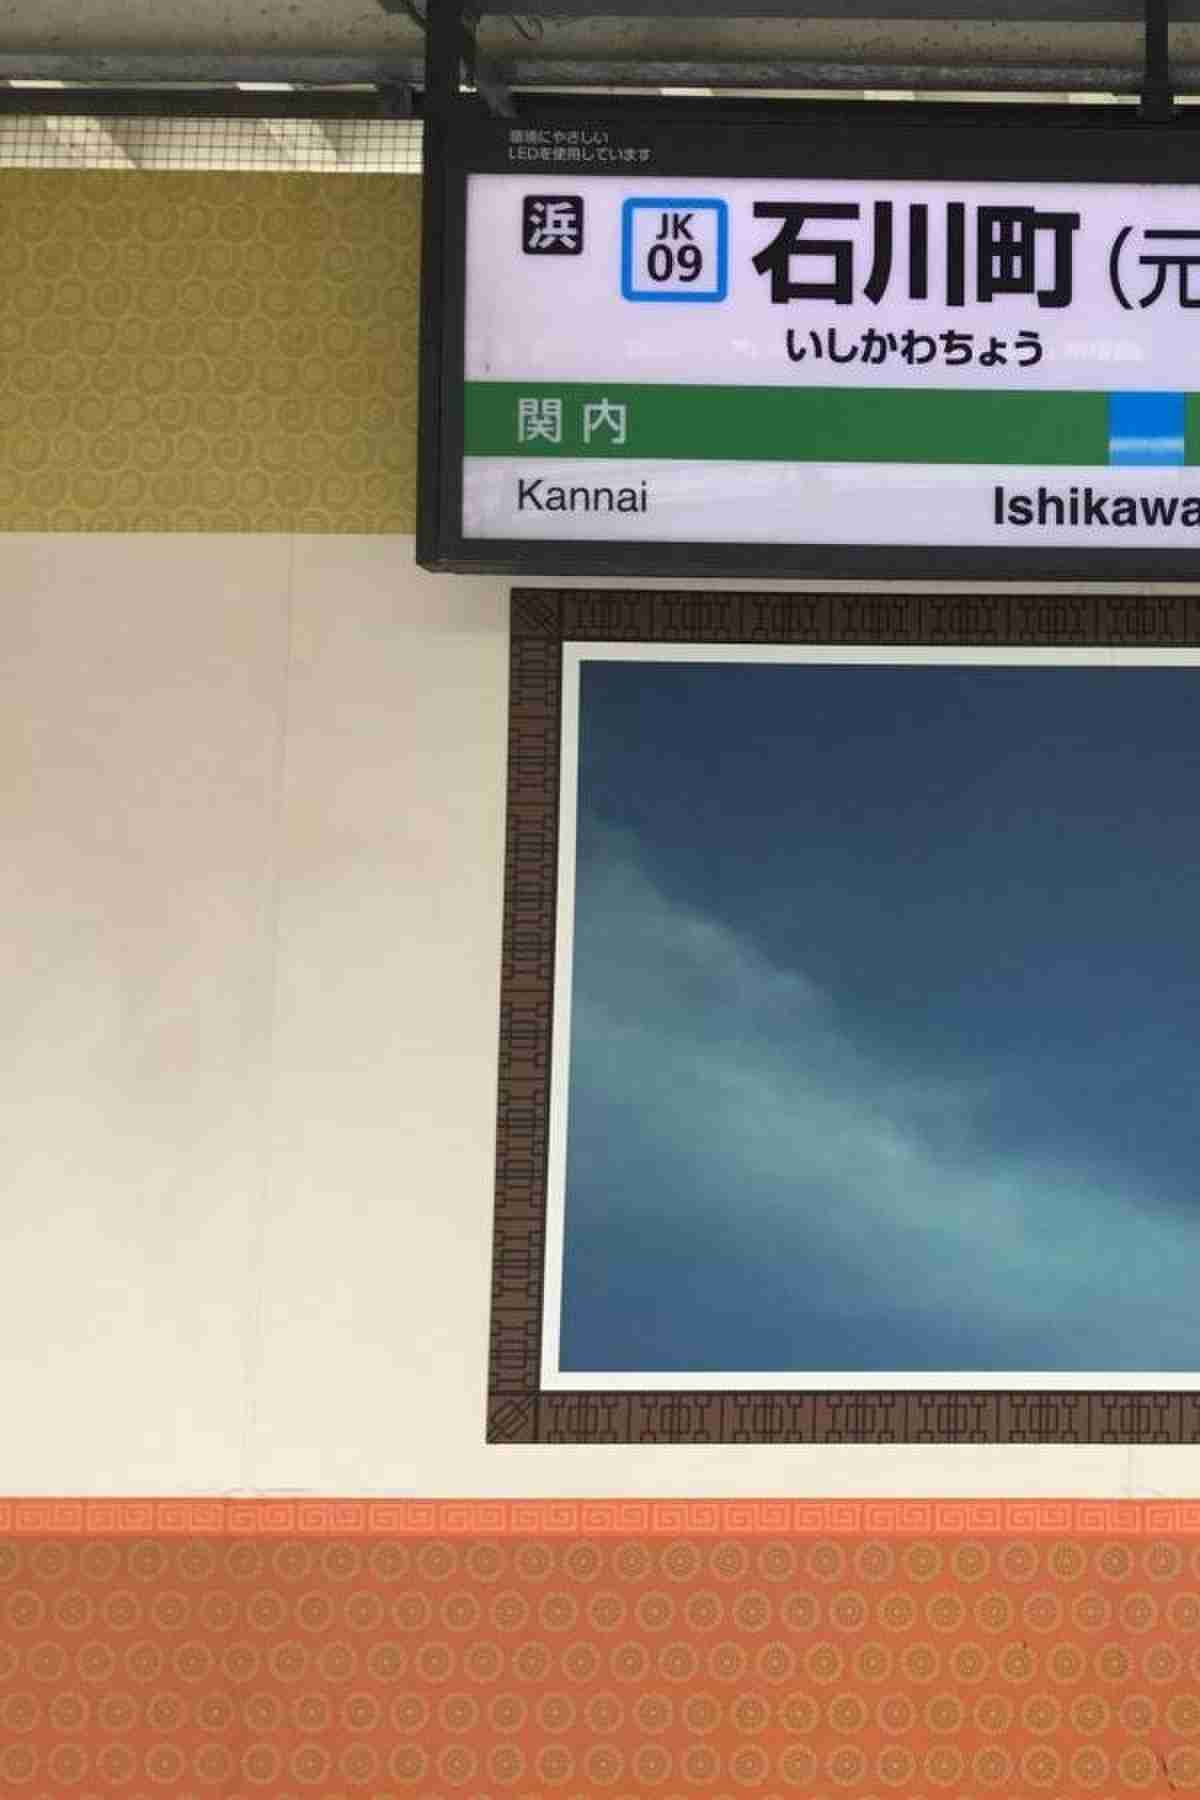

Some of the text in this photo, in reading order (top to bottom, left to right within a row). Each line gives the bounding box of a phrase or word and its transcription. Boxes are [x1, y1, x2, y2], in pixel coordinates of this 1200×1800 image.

[508, 146, 652, 162] LEDを使用しています
[528, 201, 577, 249] 浜
[655, 212, 694, 241] JK
[647, 243, 703, 283] 09
[751, 200, 1081, 309] 石川町
[786, 327, 1043, 367] いしかわちょう
[518, 397, 627, 444] 関内
[518, 478, 647, 513] Kannai
